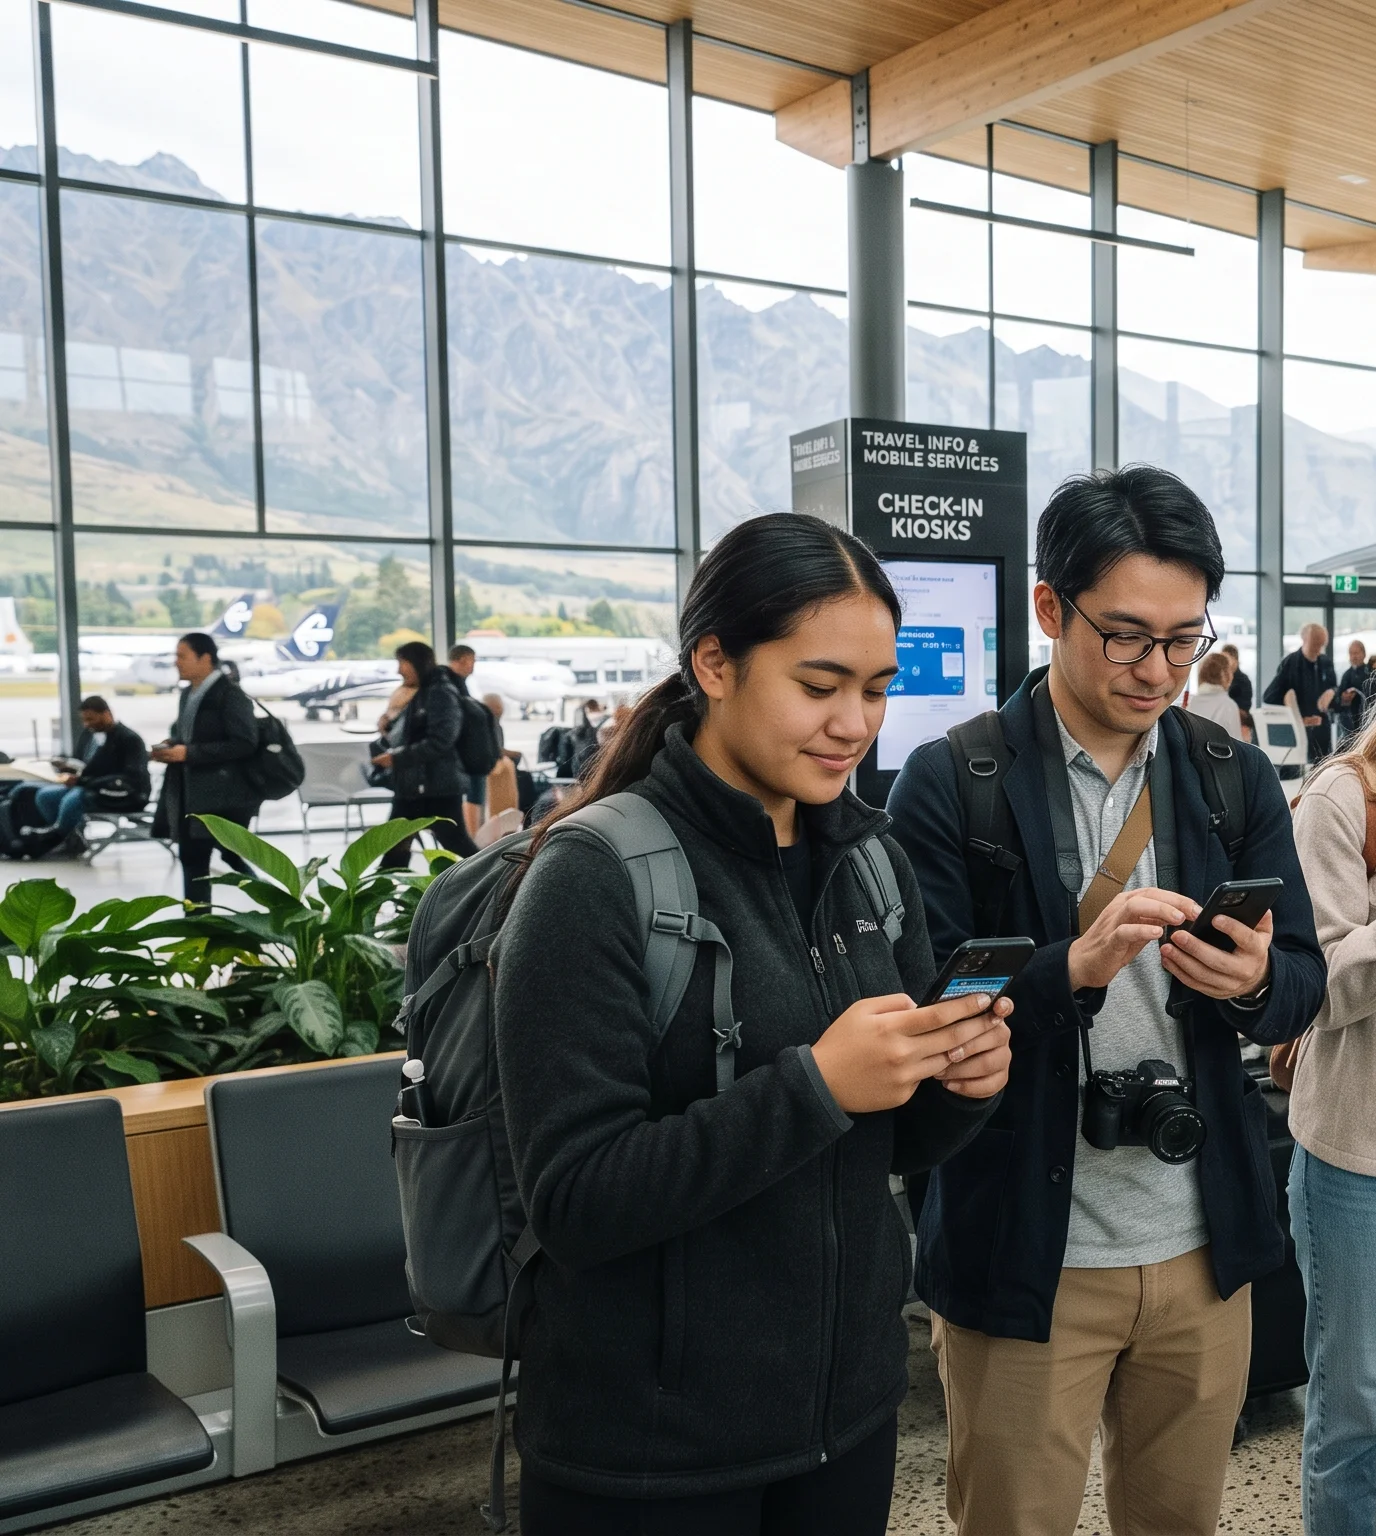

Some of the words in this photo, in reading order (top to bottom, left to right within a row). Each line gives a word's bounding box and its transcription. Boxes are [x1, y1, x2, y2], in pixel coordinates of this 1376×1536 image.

[862, 430, 925, 450] TRAVEL
[927, 435, 965, 453] INFO
[967, 438, 980, 454] &
[863, 449, 925, 468] MOBILE
[926, 453, 999, 472] SERVICES
[877, 492, 984, 518] CHECK-IN
[891, 517, 972, 541] KIOSKS
